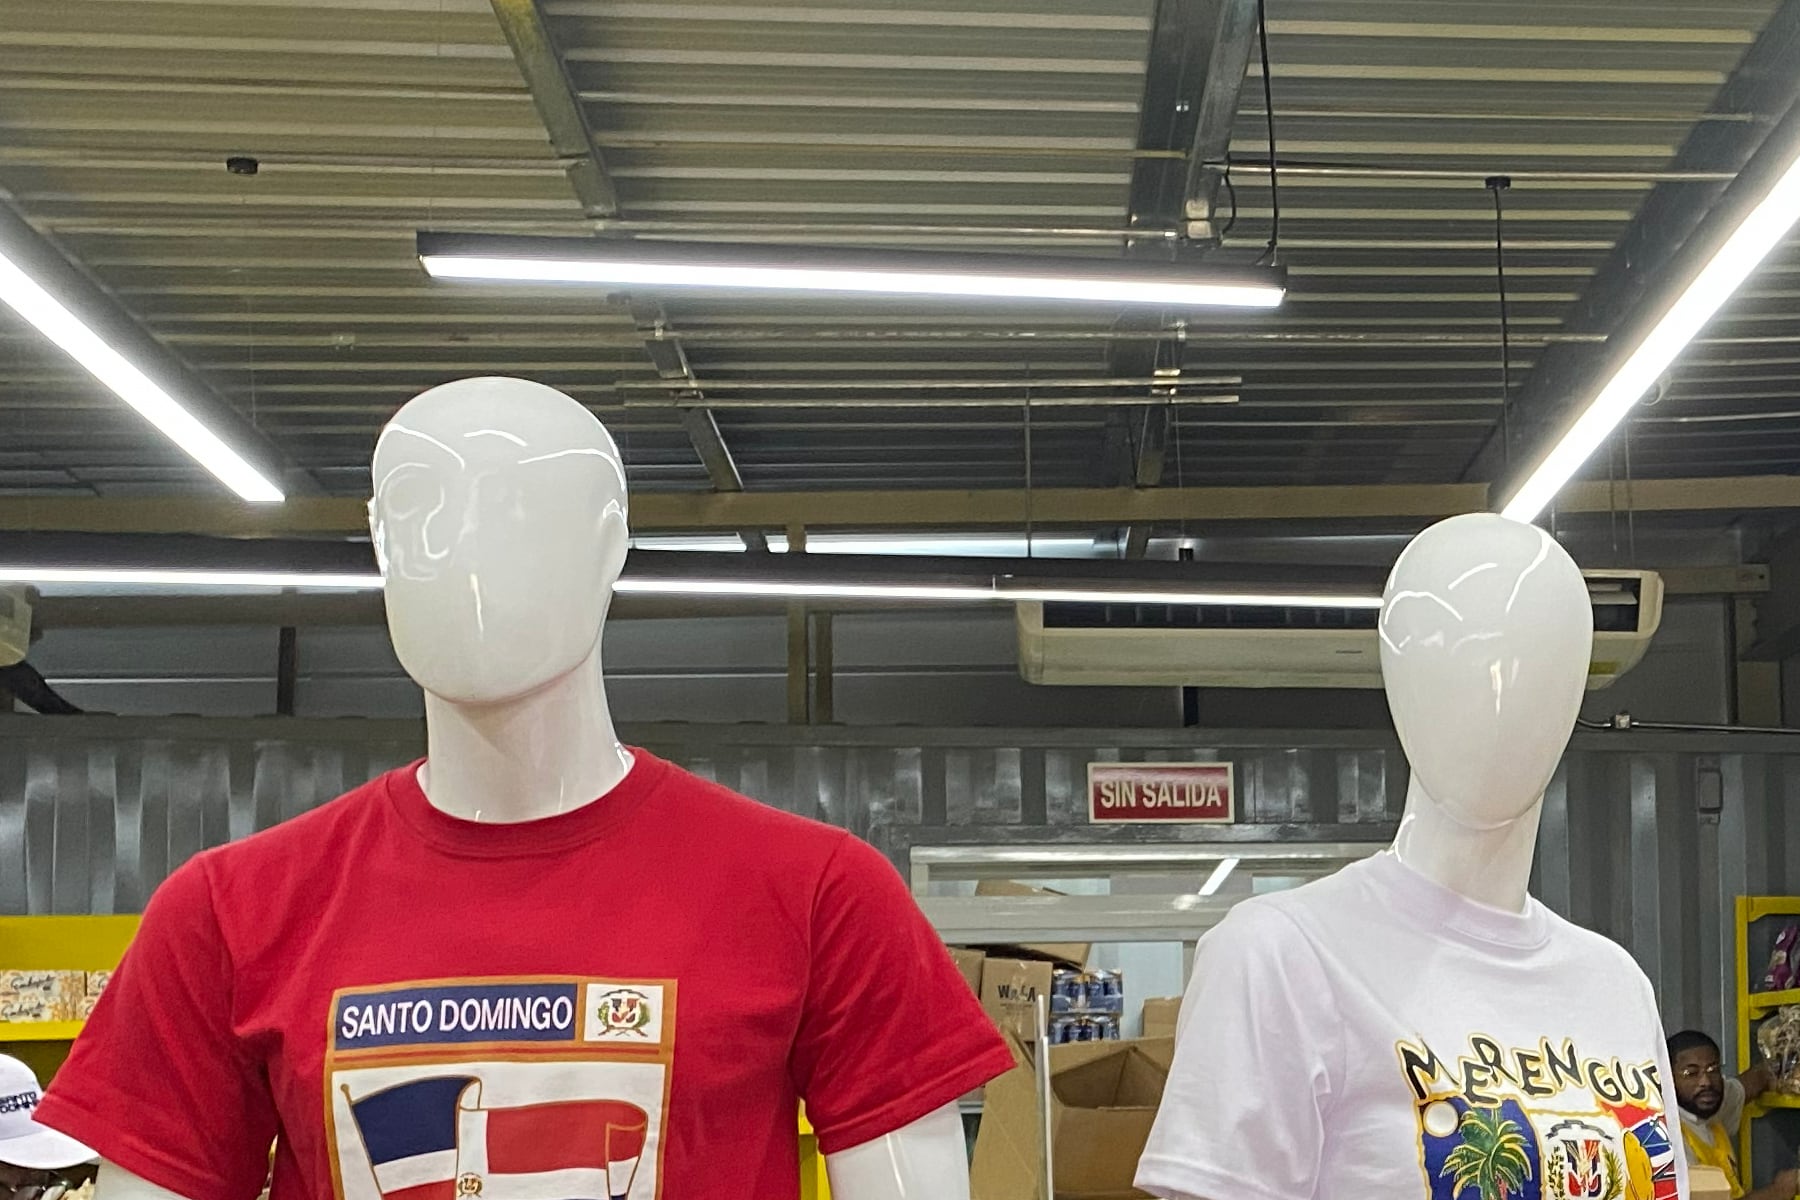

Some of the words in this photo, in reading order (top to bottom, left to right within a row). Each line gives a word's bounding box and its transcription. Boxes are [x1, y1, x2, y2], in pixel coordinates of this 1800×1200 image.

[1101, 780, 1136, 808] SIN
[1142, 780, 1222, 808] SALIDA
[341, 999, 433, 1039] SANTO
[439, 996, 573, 1032] DOMINGO
